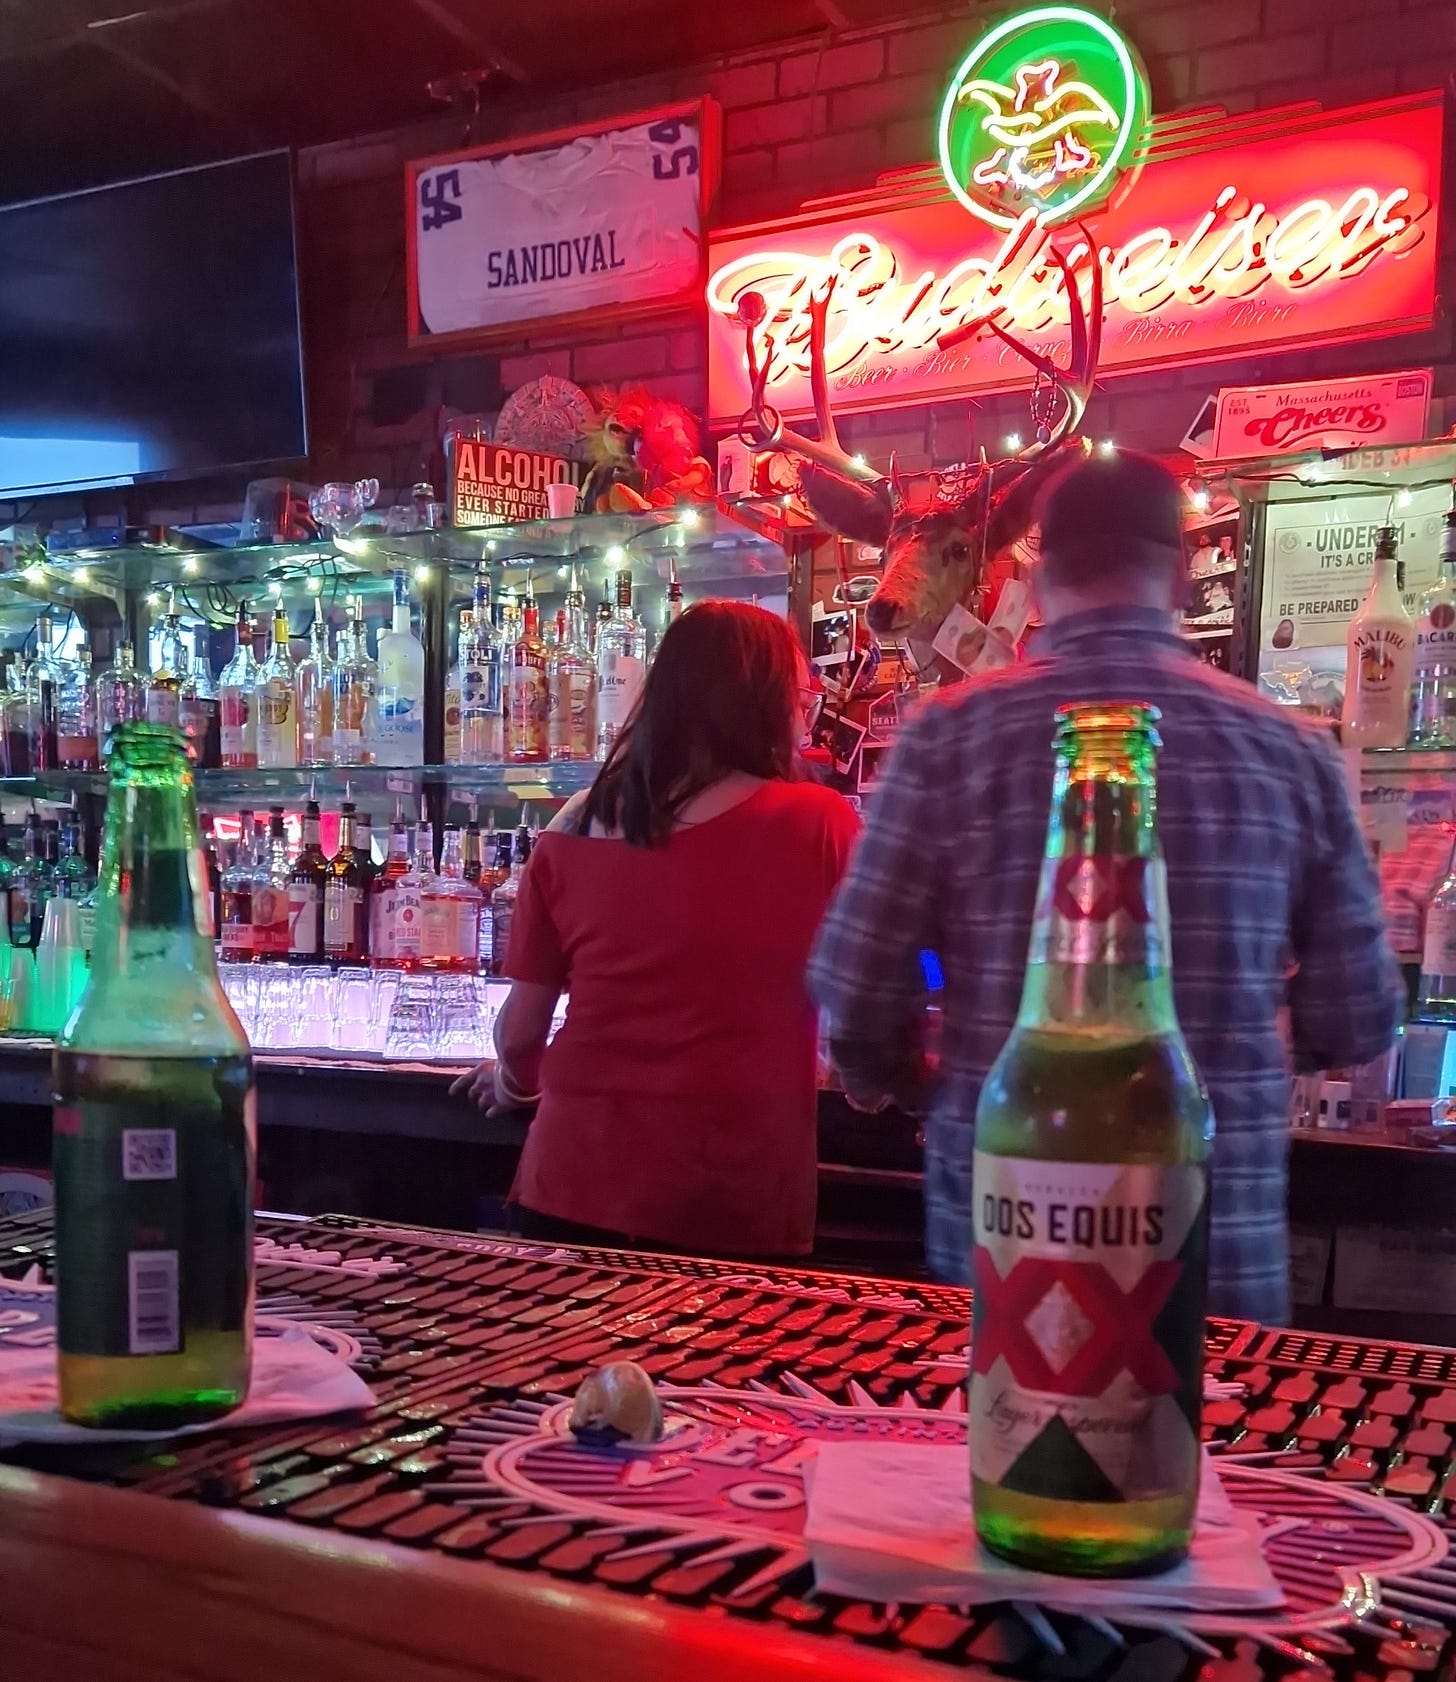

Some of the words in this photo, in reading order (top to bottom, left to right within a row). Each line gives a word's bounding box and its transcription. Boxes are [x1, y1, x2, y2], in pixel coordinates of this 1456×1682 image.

[487, 230, 625, 289] SANDOVAL
[707, 184, 1415, 372] Budweiser
[834, 361, 894, 391] Beer
[914, 350, 972, 378] Bier
[1113, 316, 1193, 346] Birra
[1276, 387, 1372, 407] Massachusetts
[1244, 402, 1386, 449] Cheers
[458, 480, 503, 500] BECAUSE
[505, 487, 520, 502] NO
[521, 489, 548, 507] GREA
[457, 494, 490, 512] EVER
[494, 500, 549, 519] STARTED
[457, 510, 505, 526] SOMEONE
[1315, 524, 1377, 552] UNDER
[1321, 554, 1342, 568] IT'S
[1345, 553, 1354, 567] A
[1280, 603, 1294, 617] BE
[1298, 598, 1359, 615] PREPARED
[1354, 630, 1406, 651] MALIBU
[1418, 630, 1456, 645] BACAR
[872, 716, 895, 725] SEAT
[984, 1194, 1035, 1241] DOS
[1048, 1204, 1165, 1249] EQUIS
